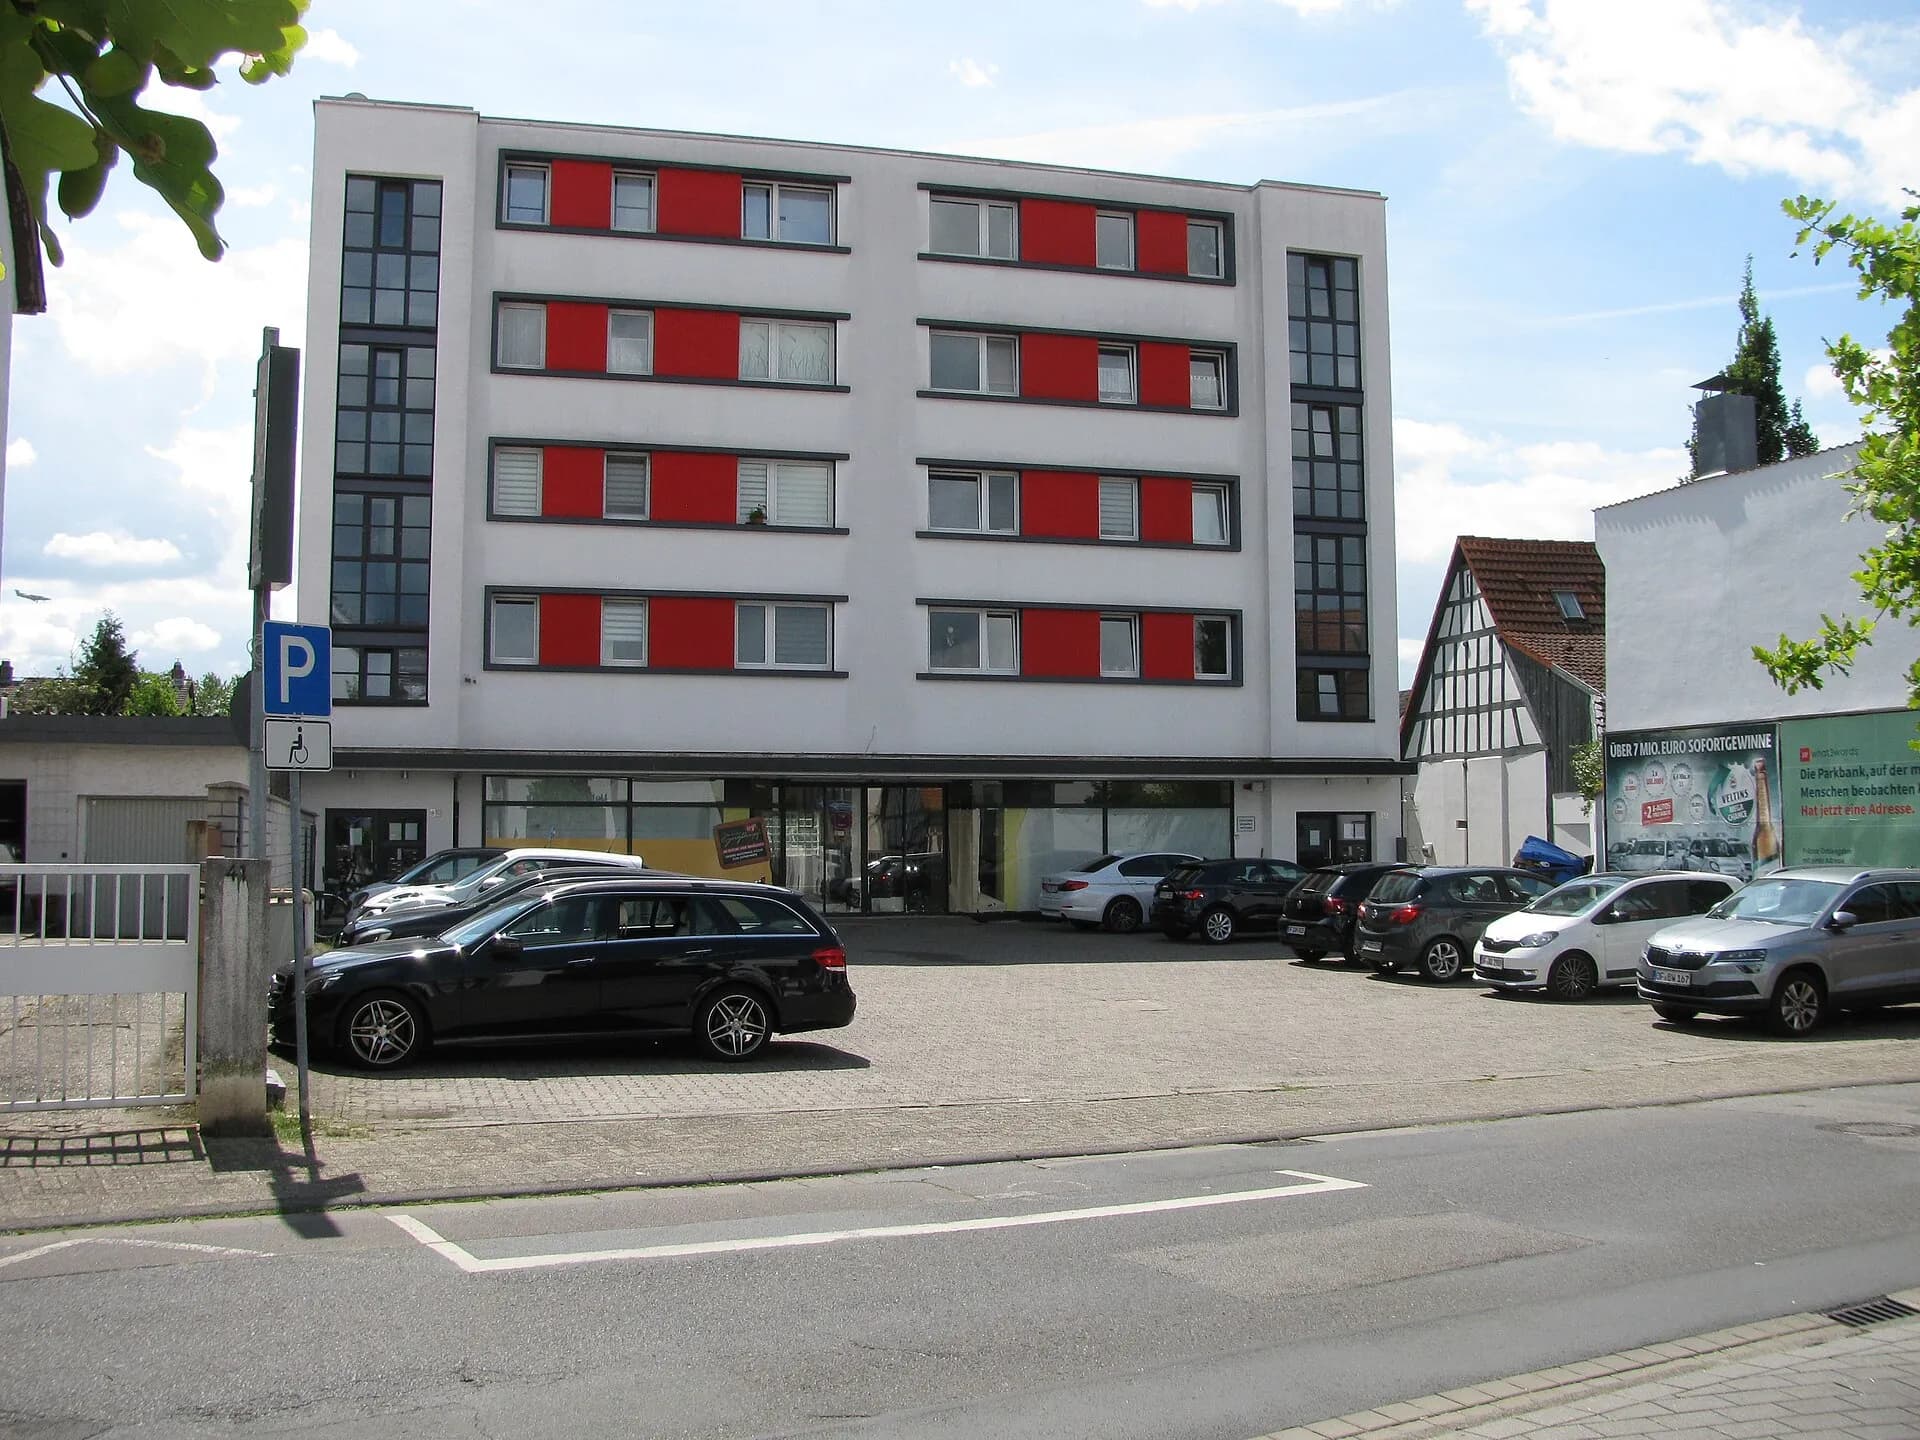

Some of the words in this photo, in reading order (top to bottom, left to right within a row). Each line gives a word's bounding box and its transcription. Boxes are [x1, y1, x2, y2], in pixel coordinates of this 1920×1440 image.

[281, 635, 315, 703] P
[1610, 742, 1632, 757] ÜBER
[1634, 743, 1639, 757] 7
[1662, 740, 1686, 754] EURO
[1688, 733, 1771, 753] SOFORTGEWINNE
[1800, 768, 1816, 779] Die
[1818, 765, 1869, 780] Parkbank,
[1870, 764, 1887, 776] auf
[1889, 763, 1908, 776] der
[1722, 789, 1749, 804] VELTINS
[1800, 786, 1849, 798] Menschen
[1851, 783, 1915, 797] beobachten
[1801, 804, 1818, 816] Hat
[1820, 803, 1842, 818] jetzt
[1845, 804, 1866, 815] eine
[1868, 802, 1915, 815] Adresse.
